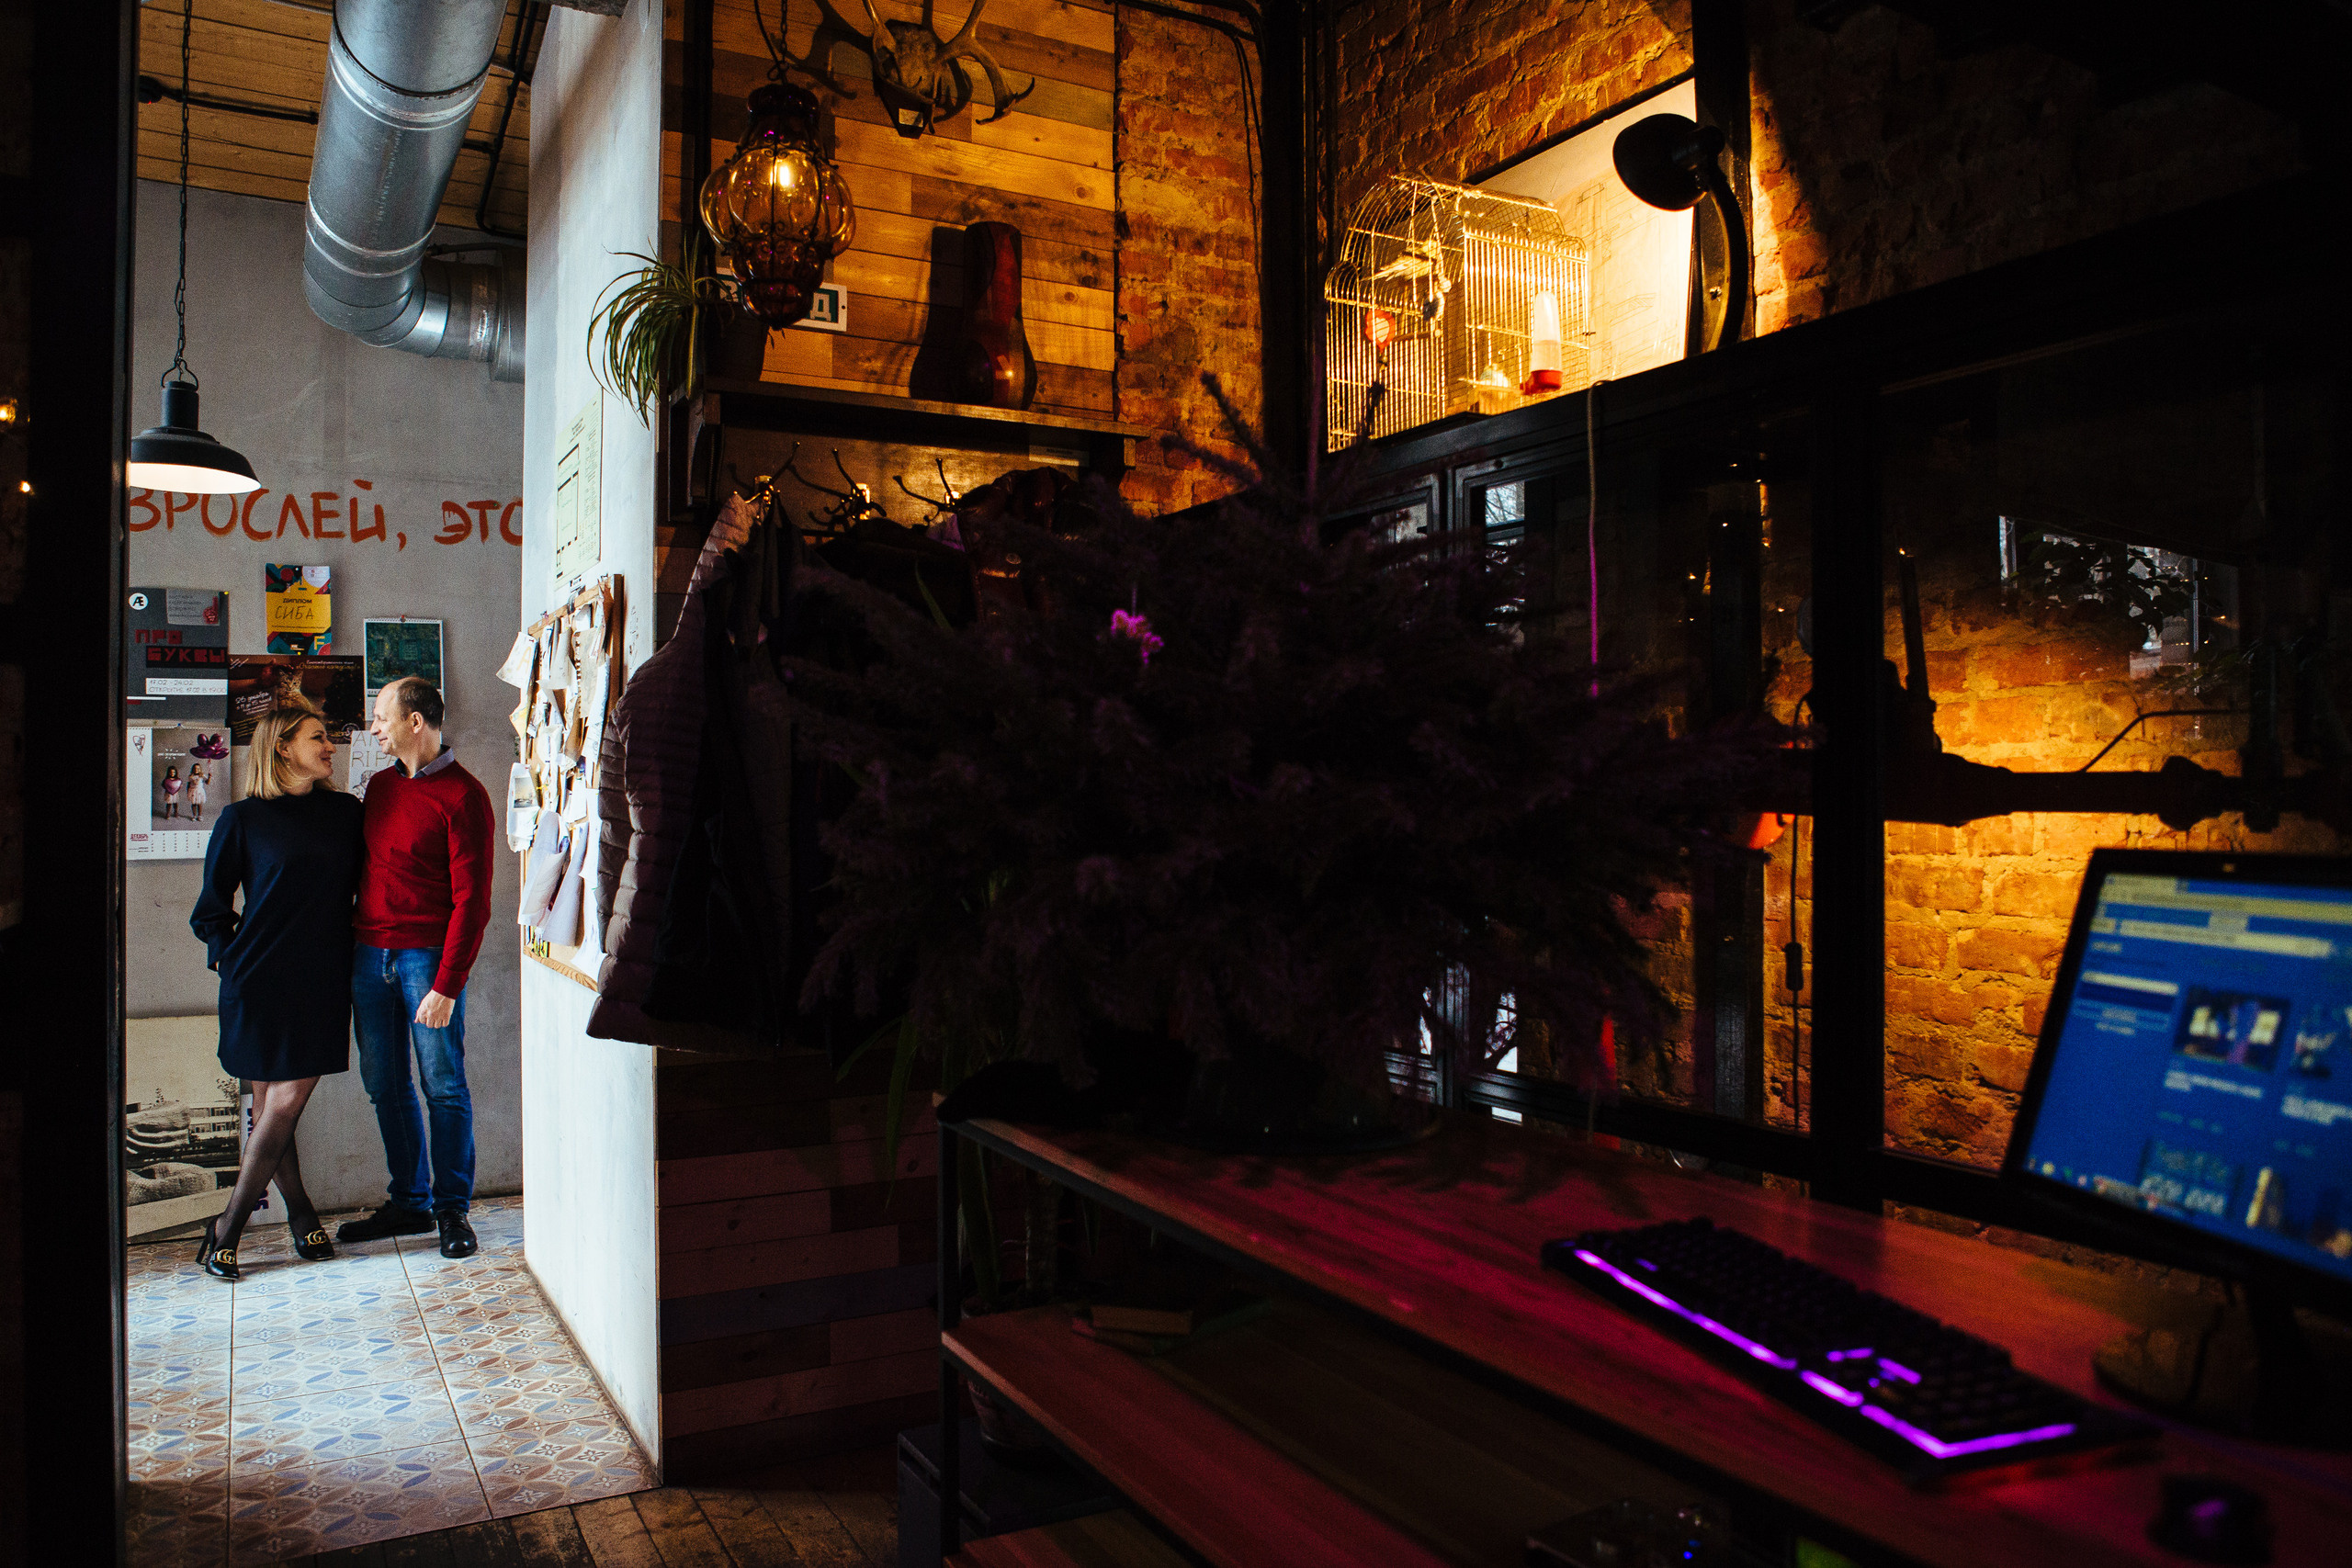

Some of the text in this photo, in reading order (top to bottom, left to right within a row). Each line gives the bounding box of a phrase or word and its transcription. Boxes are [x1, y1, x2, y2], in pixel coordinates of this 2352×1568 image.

[275, 605, 315, 620] СИБА
[135, 629, 182, 645] ПРО
[147, 648, 225, 662] БУКВЫ
